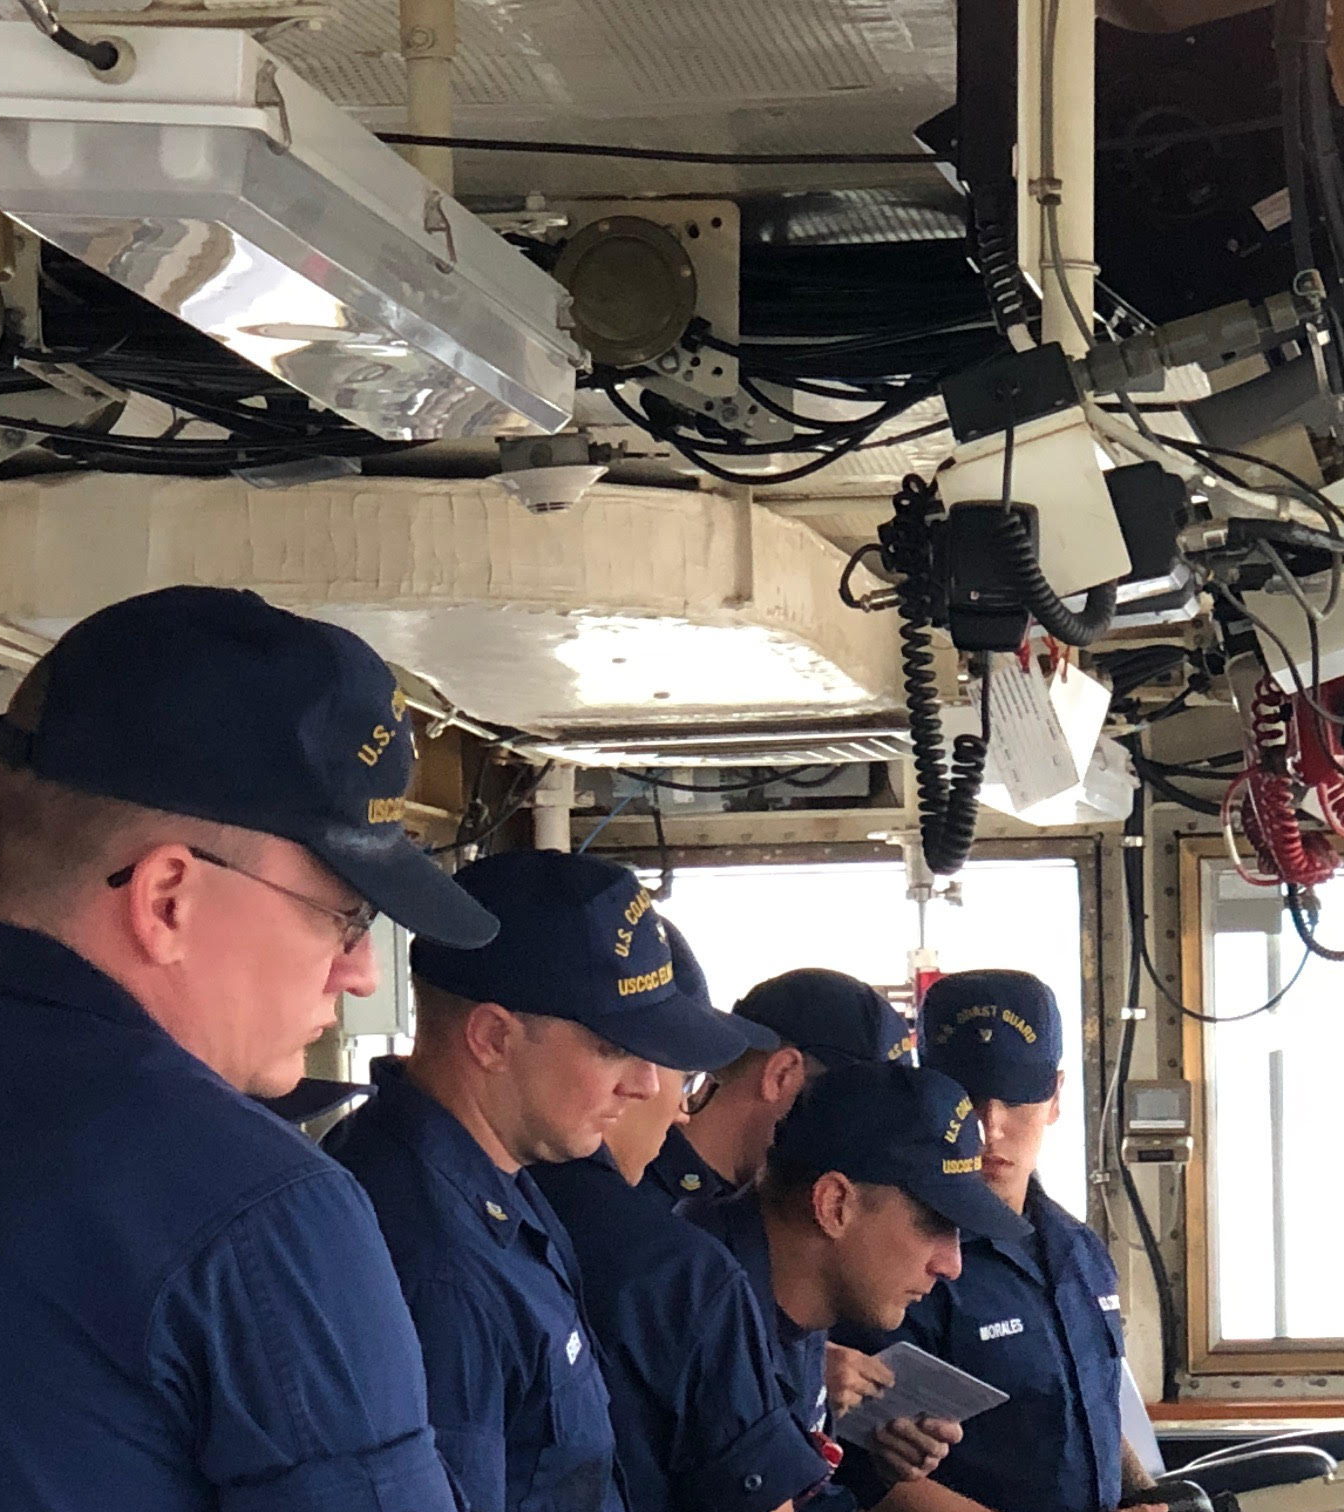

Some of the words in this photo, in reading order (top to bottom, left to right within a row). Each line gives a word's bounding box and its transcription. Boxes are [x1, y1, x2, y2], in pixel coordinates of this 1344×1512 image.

[358, 725, 396, 766] U.S.
[1002, 1009, 1037, 1044] GUARD
[979, 1318, 1024, 1341] MORALES
